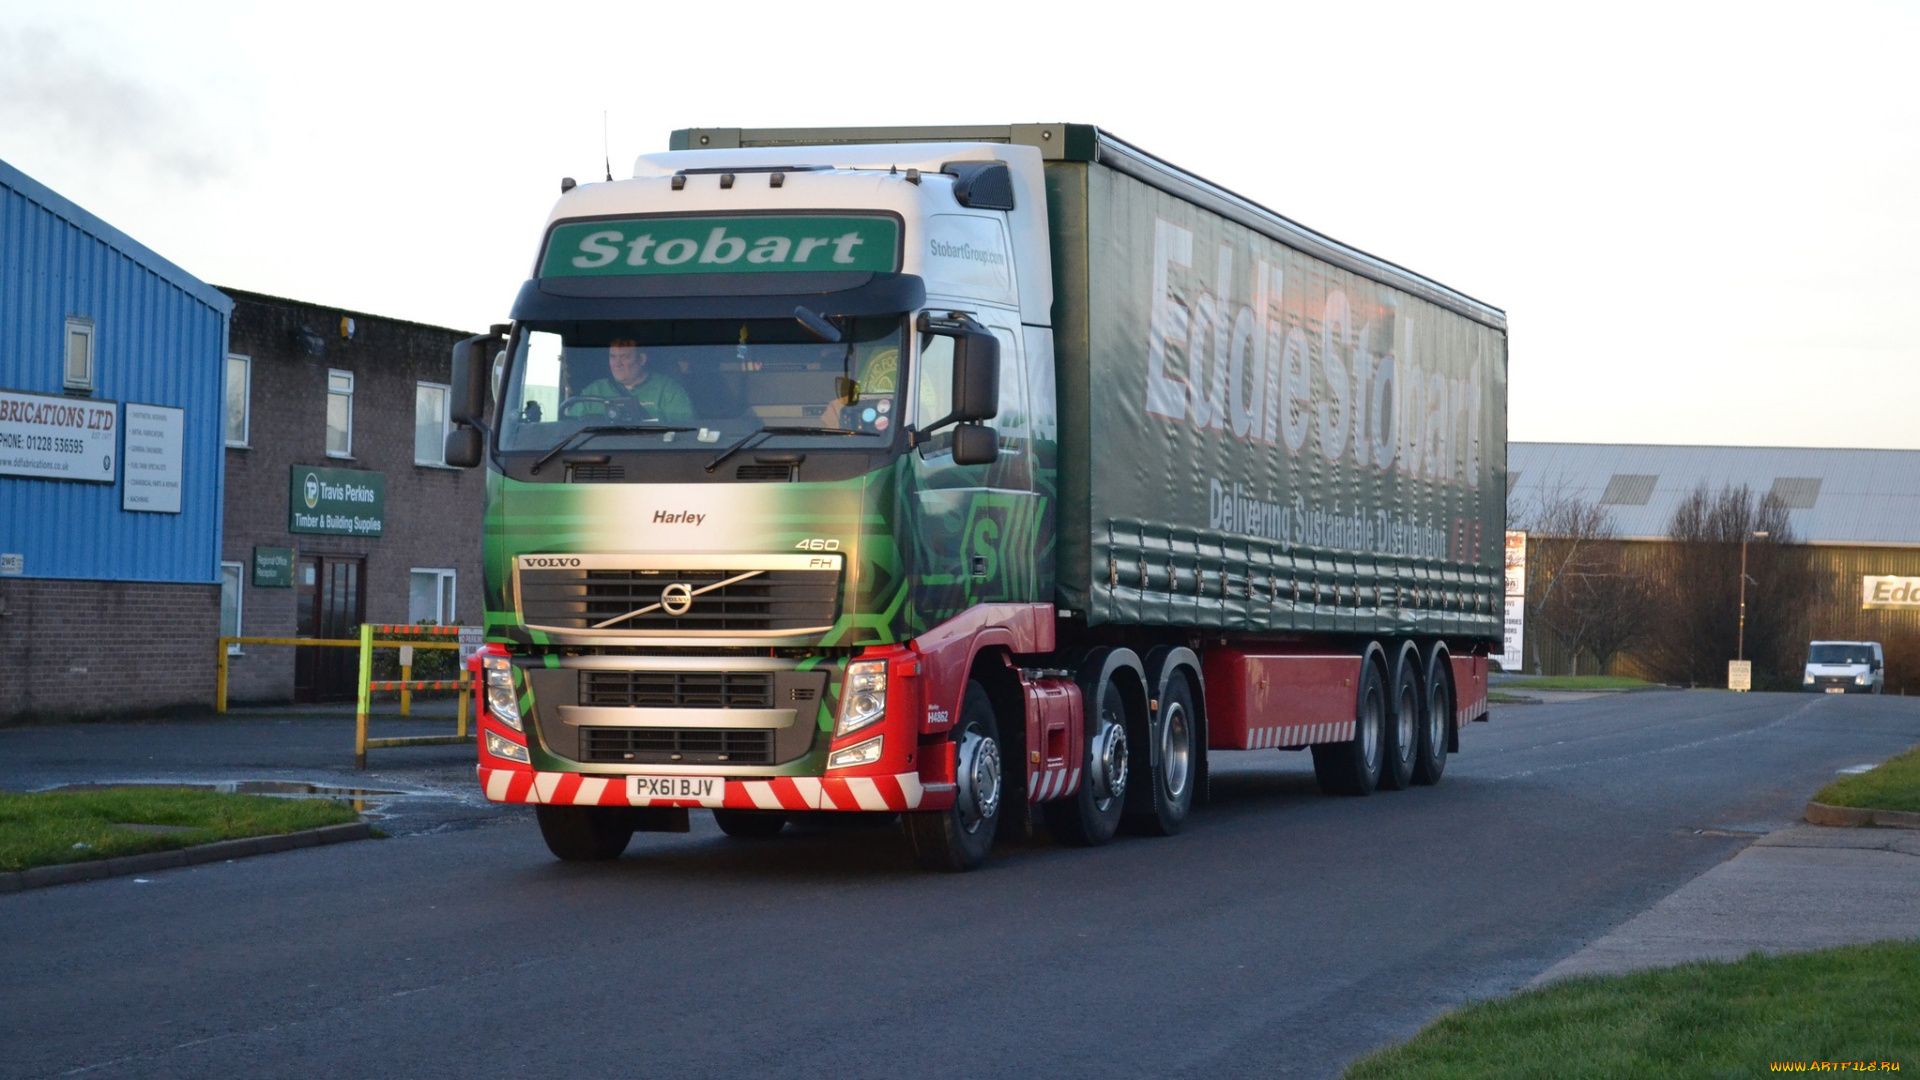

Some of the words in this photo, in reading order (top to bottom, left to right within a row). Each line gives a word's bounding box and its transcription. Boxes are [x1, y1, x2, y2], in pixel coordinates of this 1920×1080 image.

[571, 227, 864, 268] Stobart
[930, 239, 1005, 266] StobartGroup.com
[87, 409, 113, 431] LTD
[26, 435, 52, 452] 01228
[54, 437, 84, 454] 536595
[320, 482, 344, 500] Travis
[345, 484, 375, 503] Perkins
[295, 513, 318, 528] Timber
[320, 514, 325, 528] &
[326, 515, 353, 533] Building
[354, 516, 381, 534] Supplies
[653, 510, 706, 526] Harley
[1209, 478, 1290, 552] Delivering
[1295, 495, 1374, 551] Sustainable
[1377, 509, 1446, 559] Distribution
[795, 539, 840, 551] 460
[524, 558, 581, 568] VOLVO
[809, 558, 833, 568] FH
[928, 711, 949, 723] H4862
[637, 779, 675, 796] PX61
[680, 780, 713, 797] BJV
